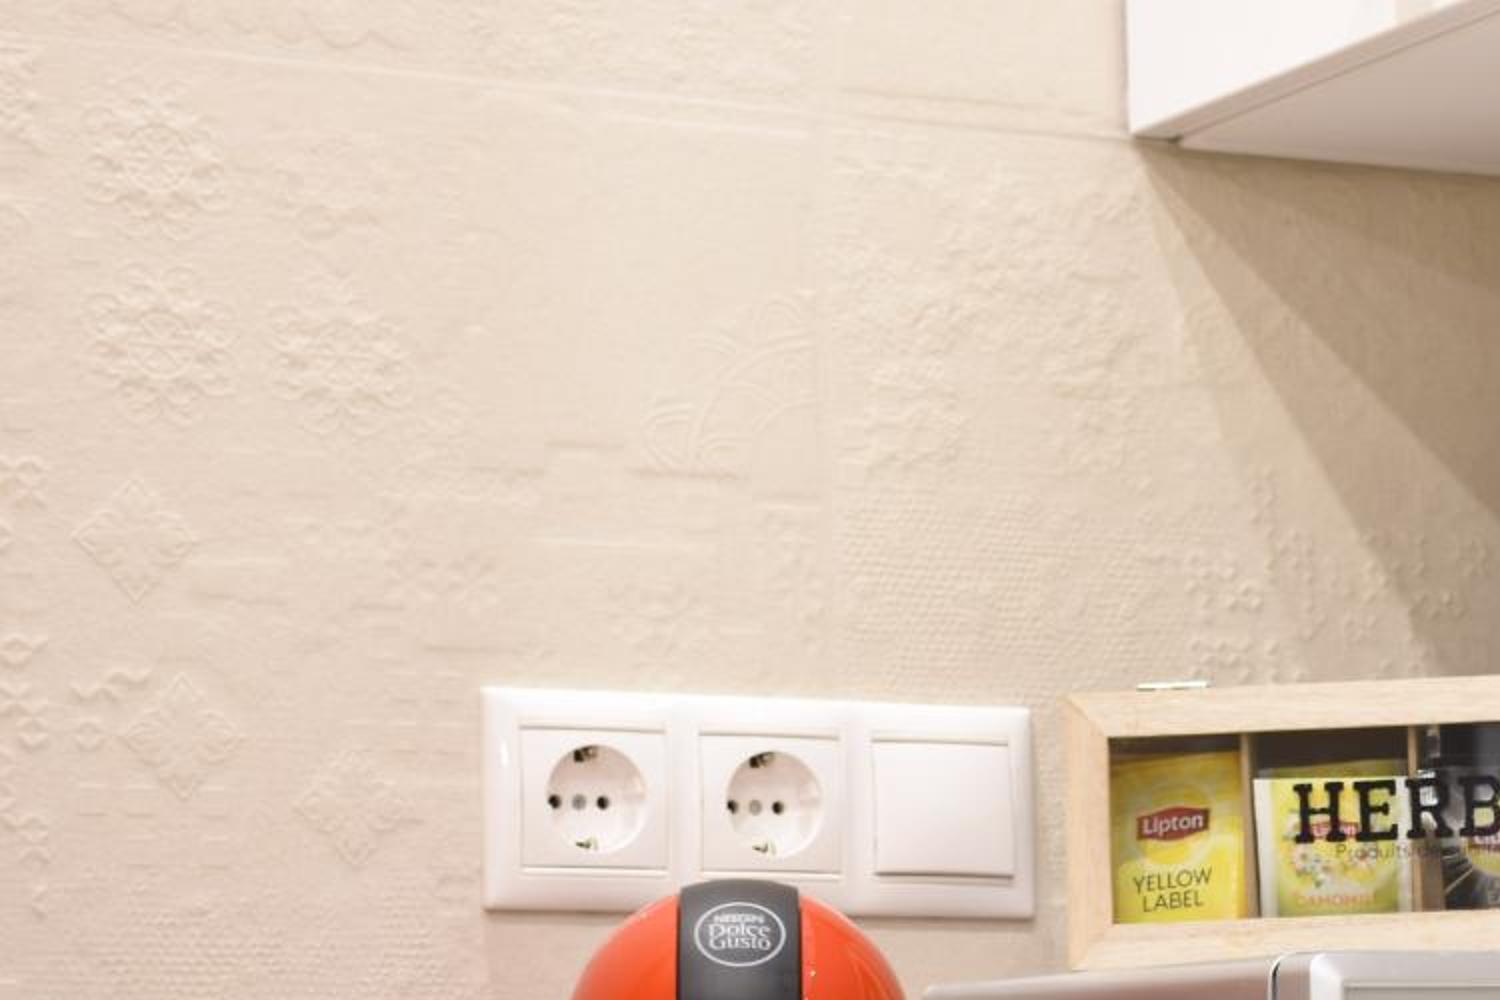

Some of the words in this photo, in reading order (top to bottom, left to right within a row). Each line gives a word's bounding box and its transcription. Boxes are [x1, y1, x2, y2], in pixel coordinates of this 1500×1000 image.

[1143, 814, 1204, 837] Lipton
[1133, 865, 1213, 894] YELLOW
[1142, 890, 1206, 913] LABEL
[709, 934, 772, 951] Gusto
